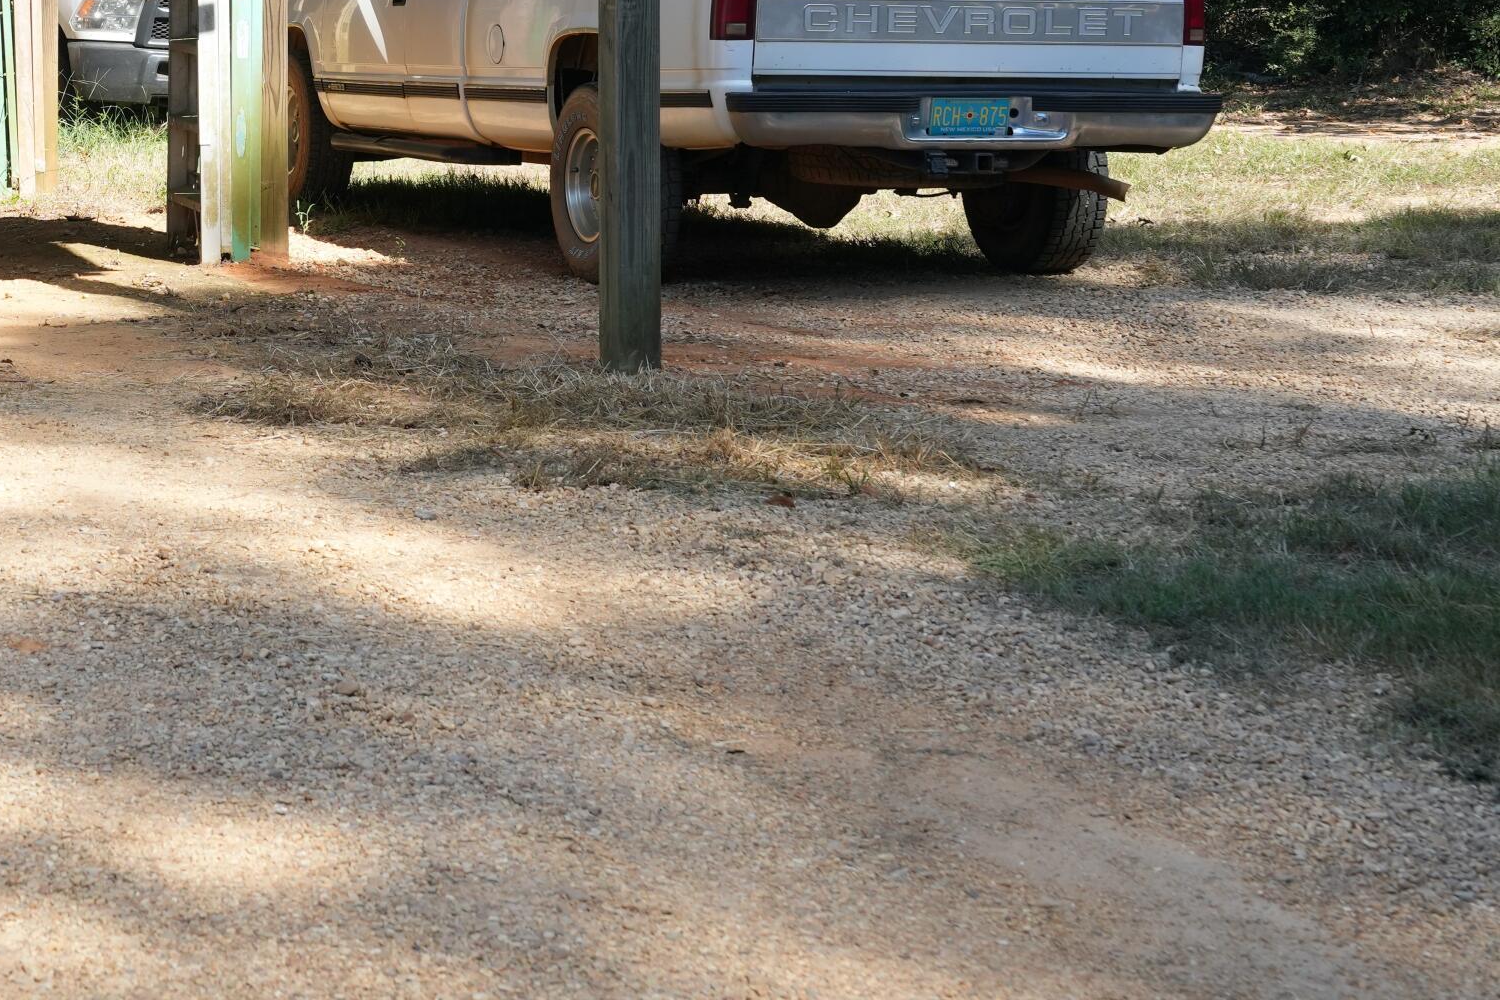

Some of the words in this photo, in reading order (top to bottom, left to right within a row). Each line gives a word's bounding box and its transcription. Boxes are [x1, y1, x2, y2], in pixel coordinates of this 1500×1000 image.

[803, 3, 1144, 36] CHEVROLET
[932, 105, 961, 127] RCH
[979, 106, 1008, 127] 875
